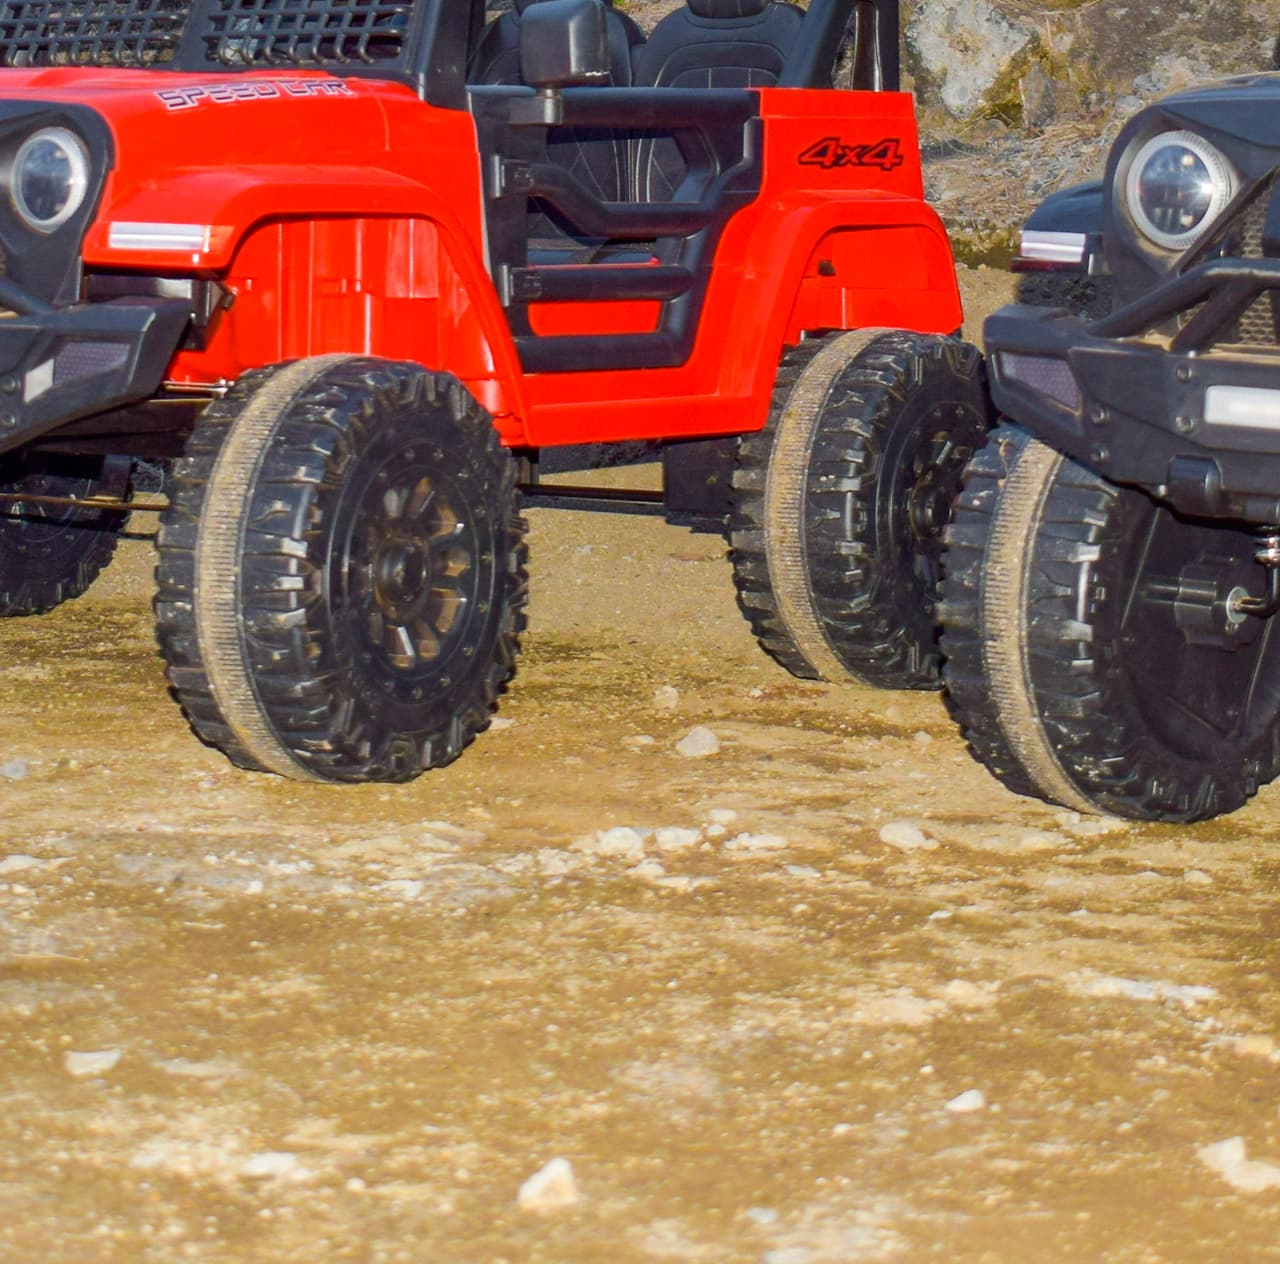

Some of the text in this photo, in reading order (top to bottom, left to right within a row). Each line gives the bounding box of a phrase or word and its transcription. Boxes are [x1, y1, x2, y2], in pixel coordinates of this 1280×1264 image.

[157, 80, 357, 109] SPEED CAR
[798, 137, 904, 171] 4x4
